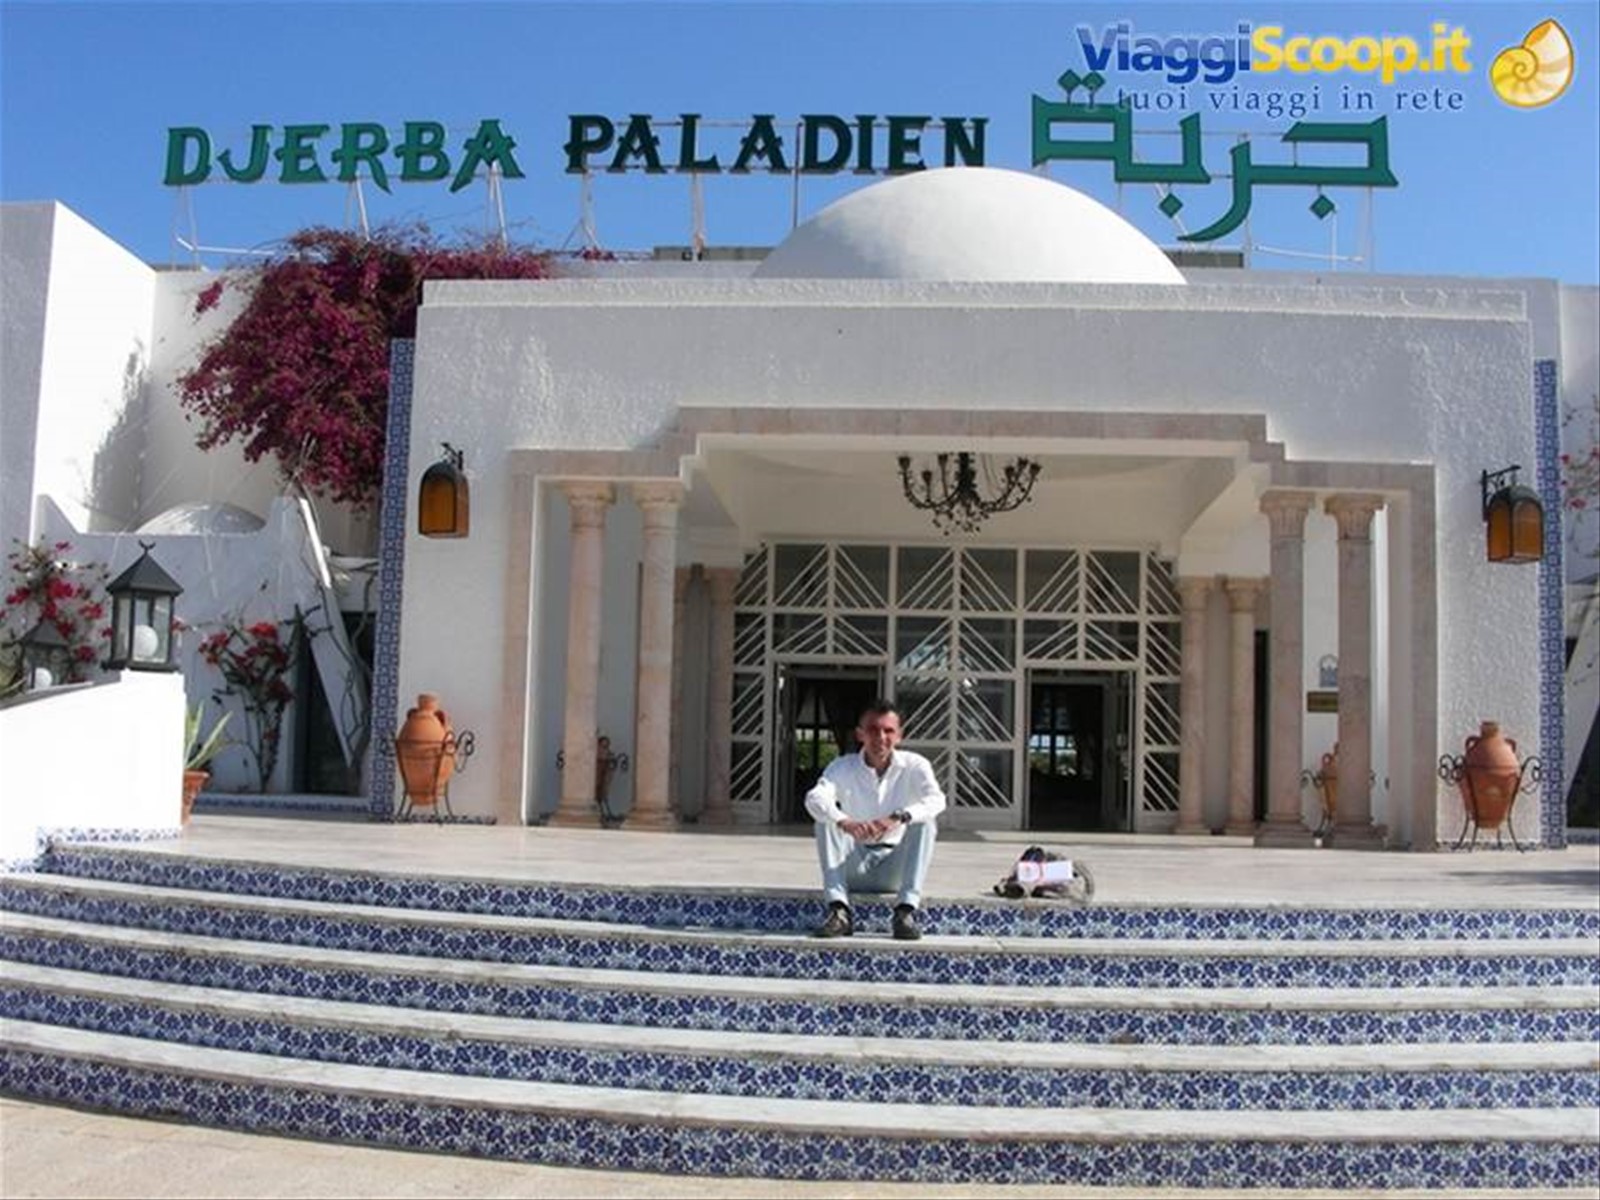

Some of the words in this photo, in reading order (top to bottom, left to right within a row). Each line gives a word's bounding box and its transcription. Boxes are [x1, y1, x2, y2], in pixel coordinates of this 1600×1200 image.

[164, 119, 525, 194] DJERBA
[564, 113, 989, 174] PALADIEN
[1032, 69, 1398, 242] جربة
